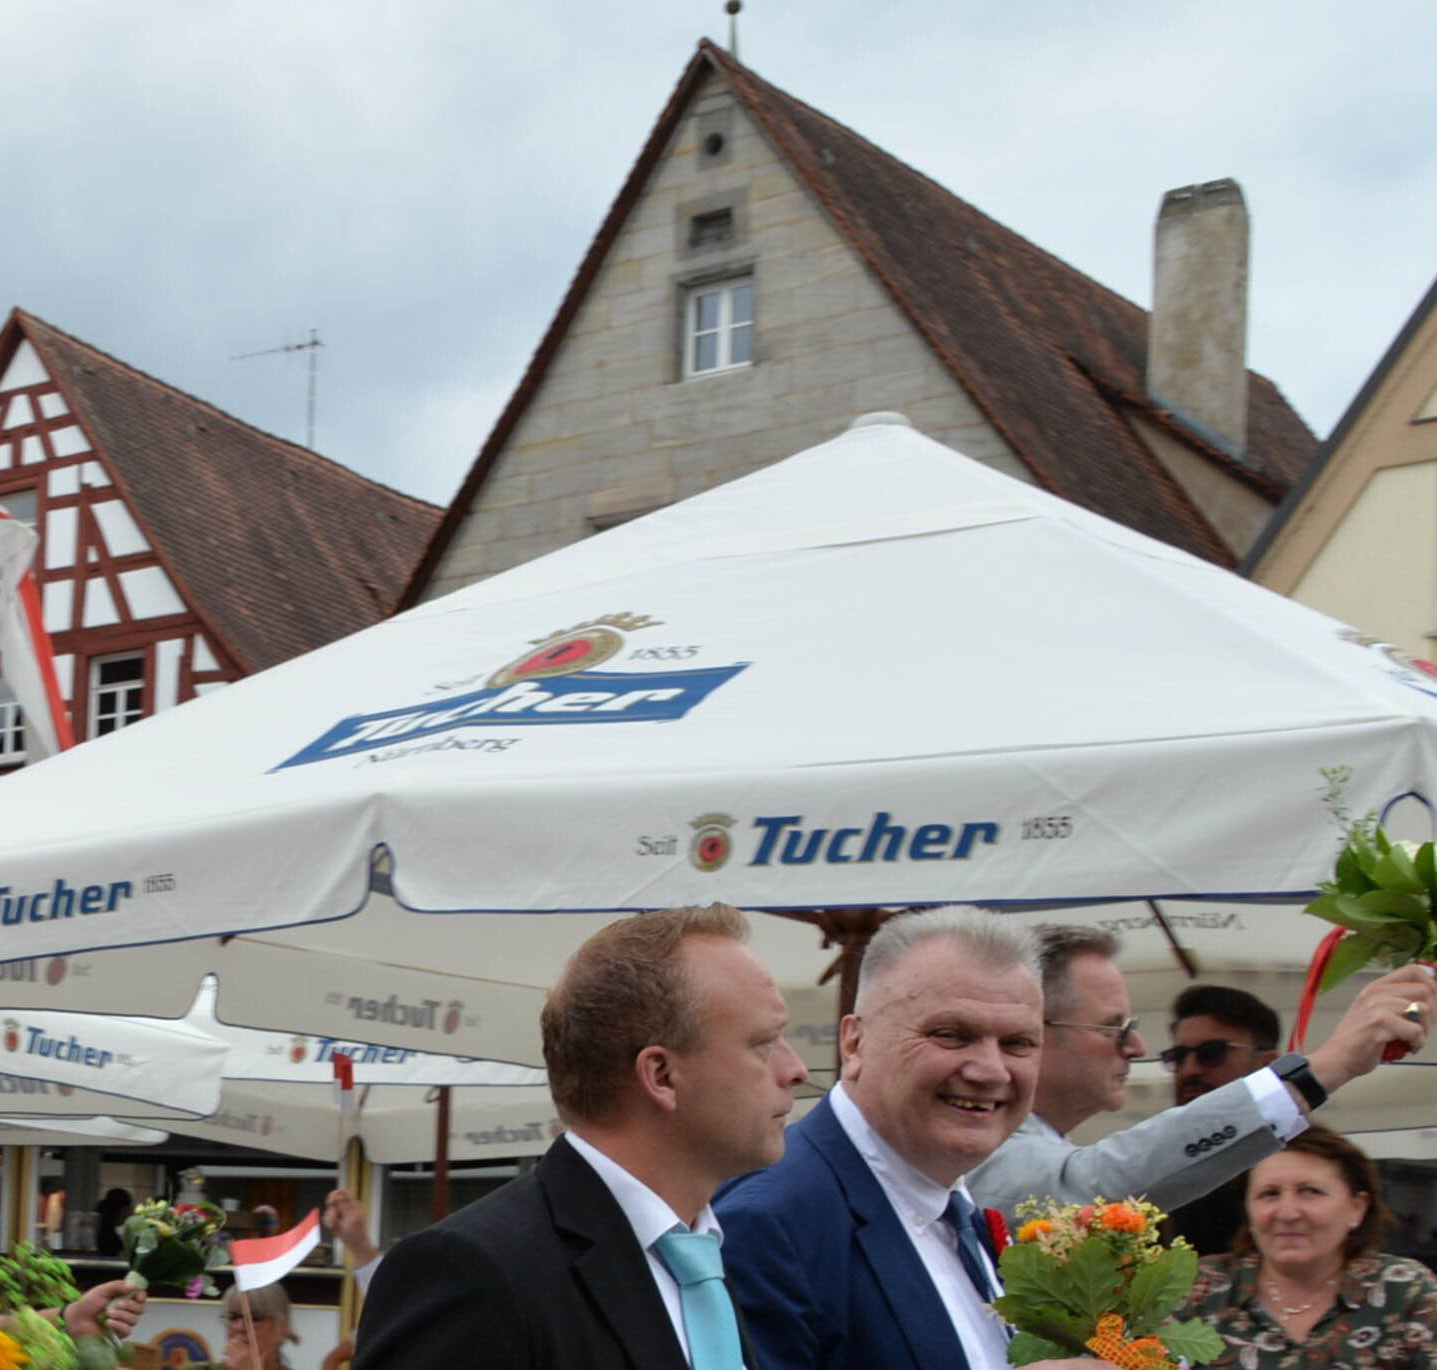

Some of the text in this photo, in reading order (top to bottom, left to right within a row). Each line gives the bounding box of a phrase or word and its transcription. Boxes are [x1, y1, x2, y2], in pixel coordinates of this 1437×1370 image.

[628, 645, 703, 661] 1855
[323, 681, 686, 752] Tucher
[634, 812, 1074, 867] Seit Tucher 1855
[25, 1025, 114, 1069] Tucher
